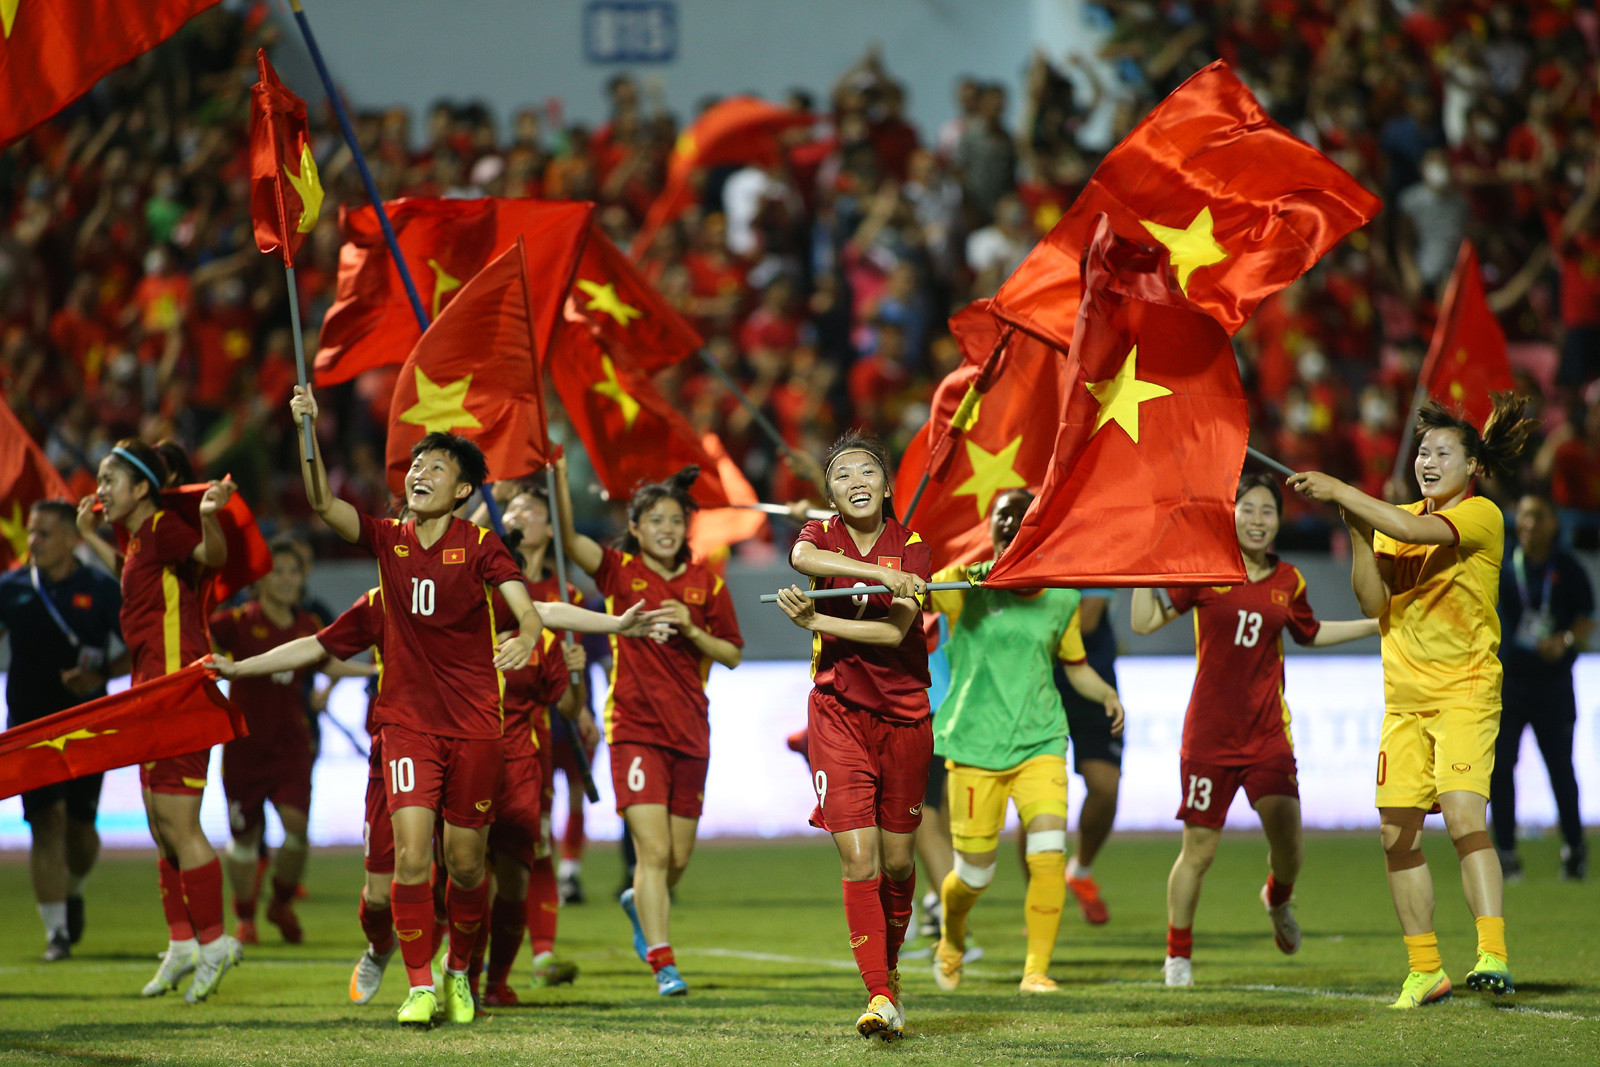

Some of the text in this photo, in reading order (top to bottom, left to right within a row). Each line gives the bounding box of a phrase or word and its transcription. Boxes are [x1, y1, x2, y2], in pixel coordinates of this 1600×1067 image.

[411, 577, 436, 616] 10
[851, 581, 869, 620] 9
[1234, 609, 1262, 648] 13
[389, 756, 416, 795] 10
[627, 756, 646, 792] 6
[814, 769, 828, 809] 9
[1186, 774, 1212, 811] 13
[967, 787, 974, 819] 1
